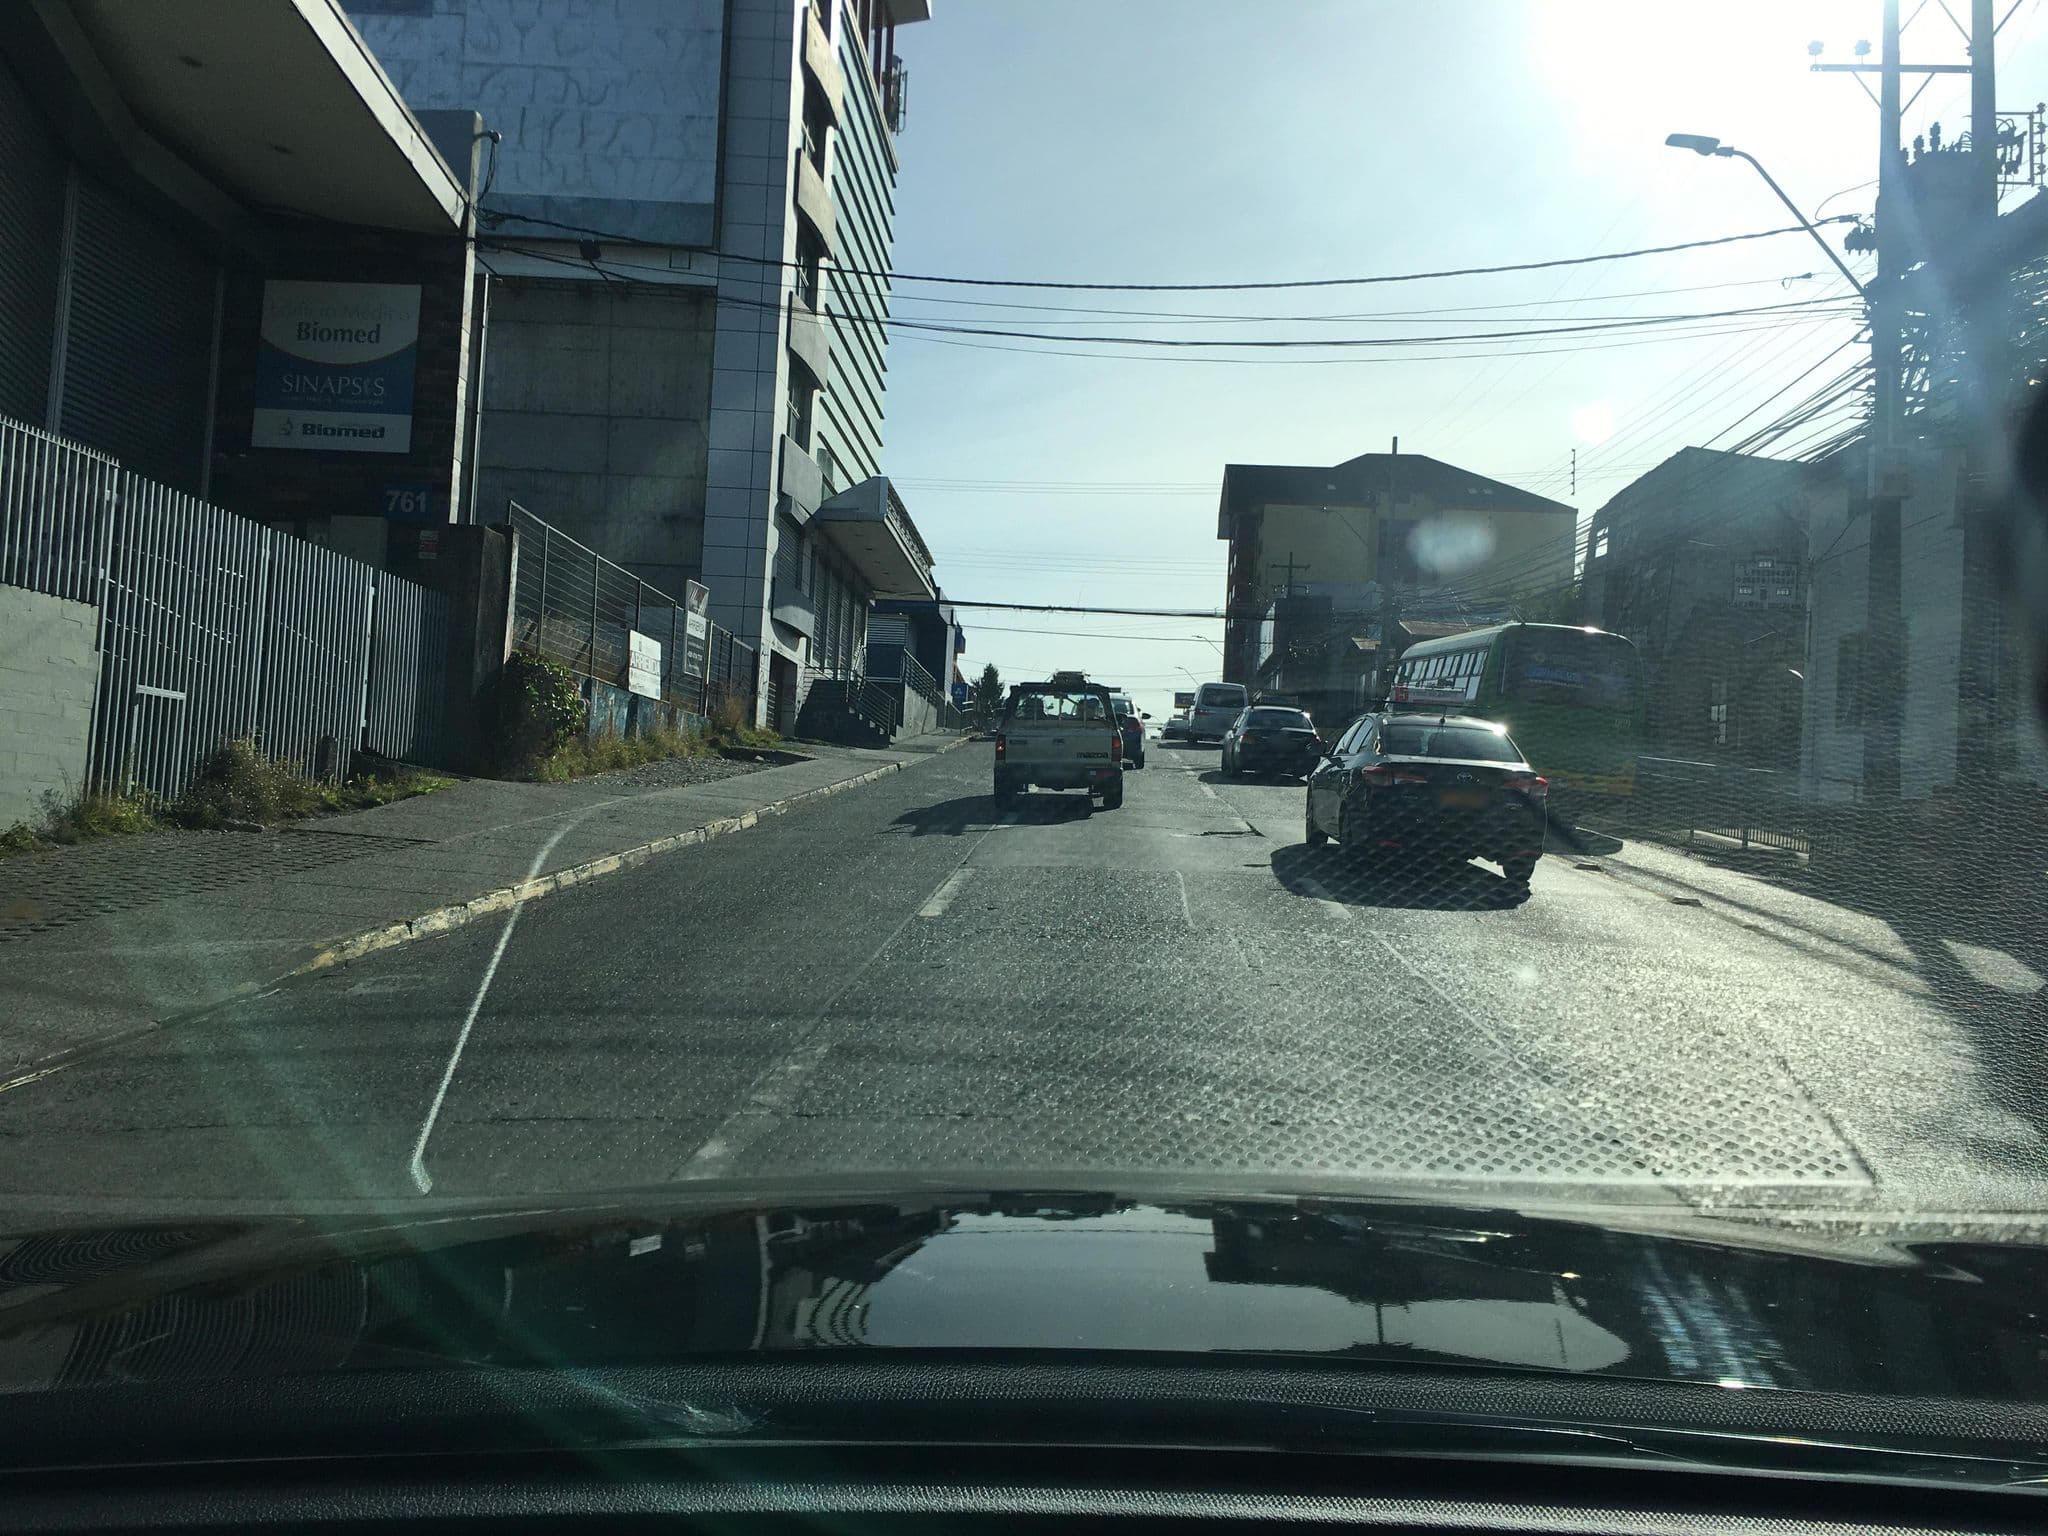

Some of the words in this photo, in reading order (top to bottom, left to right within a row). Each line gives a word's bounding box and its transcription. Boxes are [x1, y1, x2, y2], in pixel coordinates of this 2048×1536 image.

[297, 321, 382, 345] Biomed
[281, 374, 386, 397] SINAPSIS
[302, 422, 386, 439] Biomed
[386, 491, 427, 513] 761
